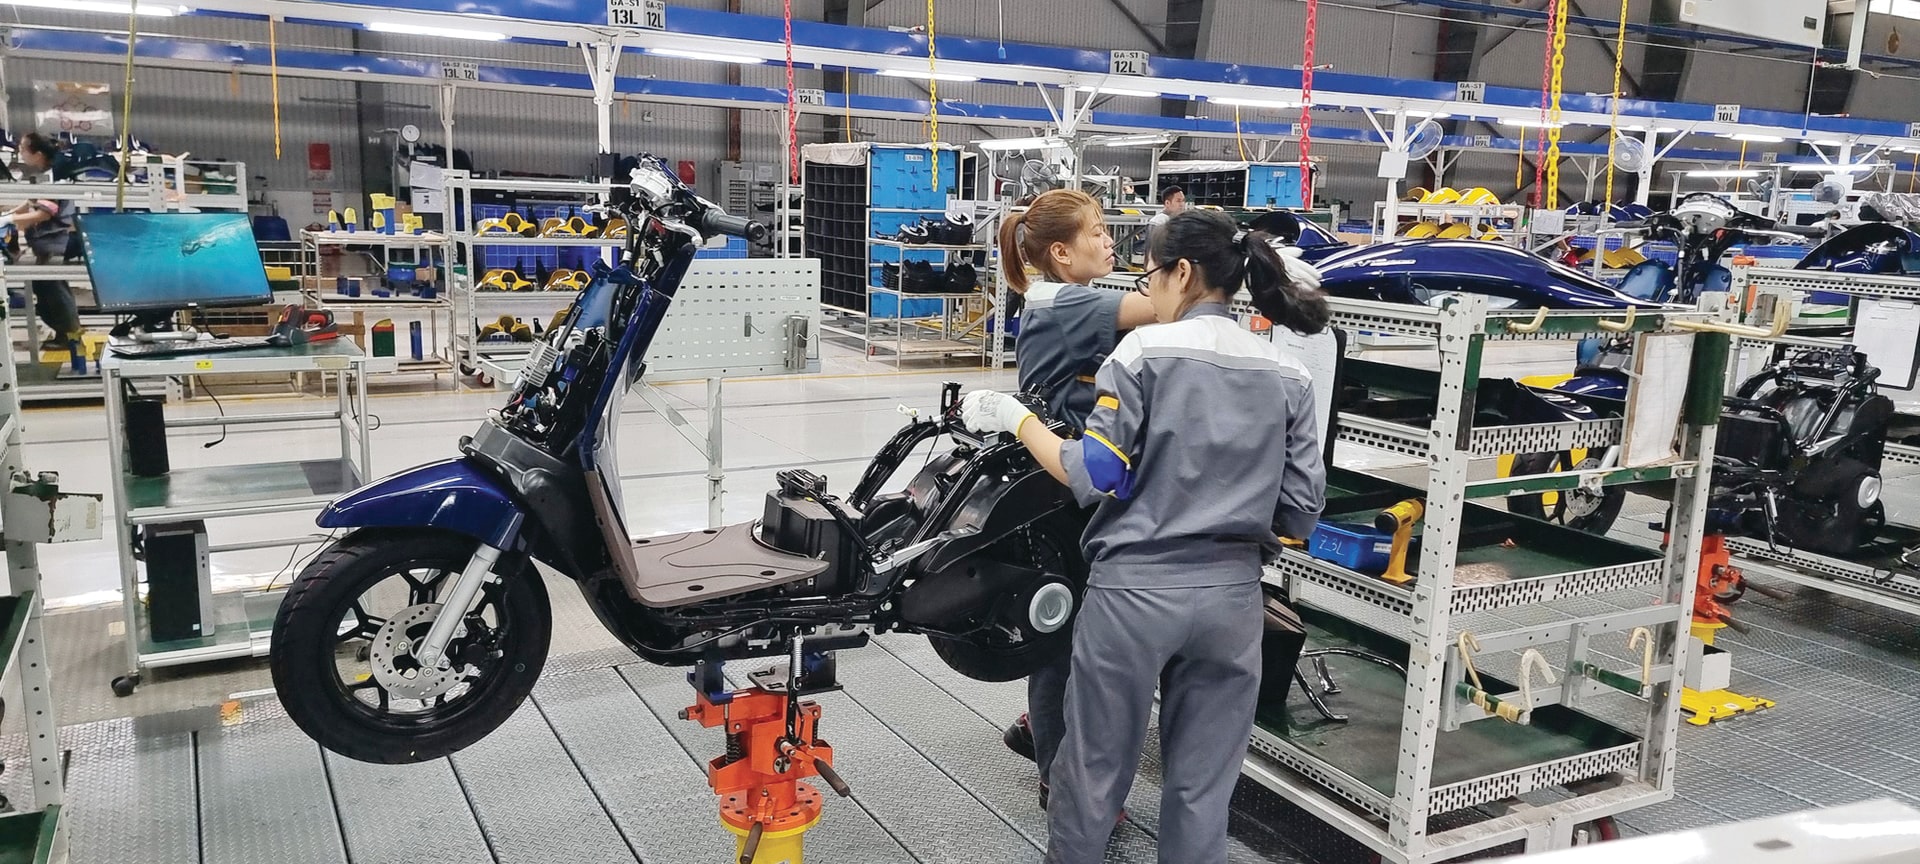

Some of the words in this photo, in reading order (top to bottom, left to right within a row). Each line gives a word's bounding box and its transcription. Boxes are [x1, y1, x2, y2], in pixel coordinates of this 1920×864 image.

[646, 1, 664, 11] GA-S1
[612, 9, 639, 25] 13L
[647, 11, 664, 28] 12L
[1114, 60, 1136, 73] 12L
[444, 68, 460, 79] 13L
[464, 69, 476, 80] 12L
[799, 95, 813, 105] 12L
[1461, 90, 1478, 101] 11L
[1717, 112, 1735, 121] 10L
